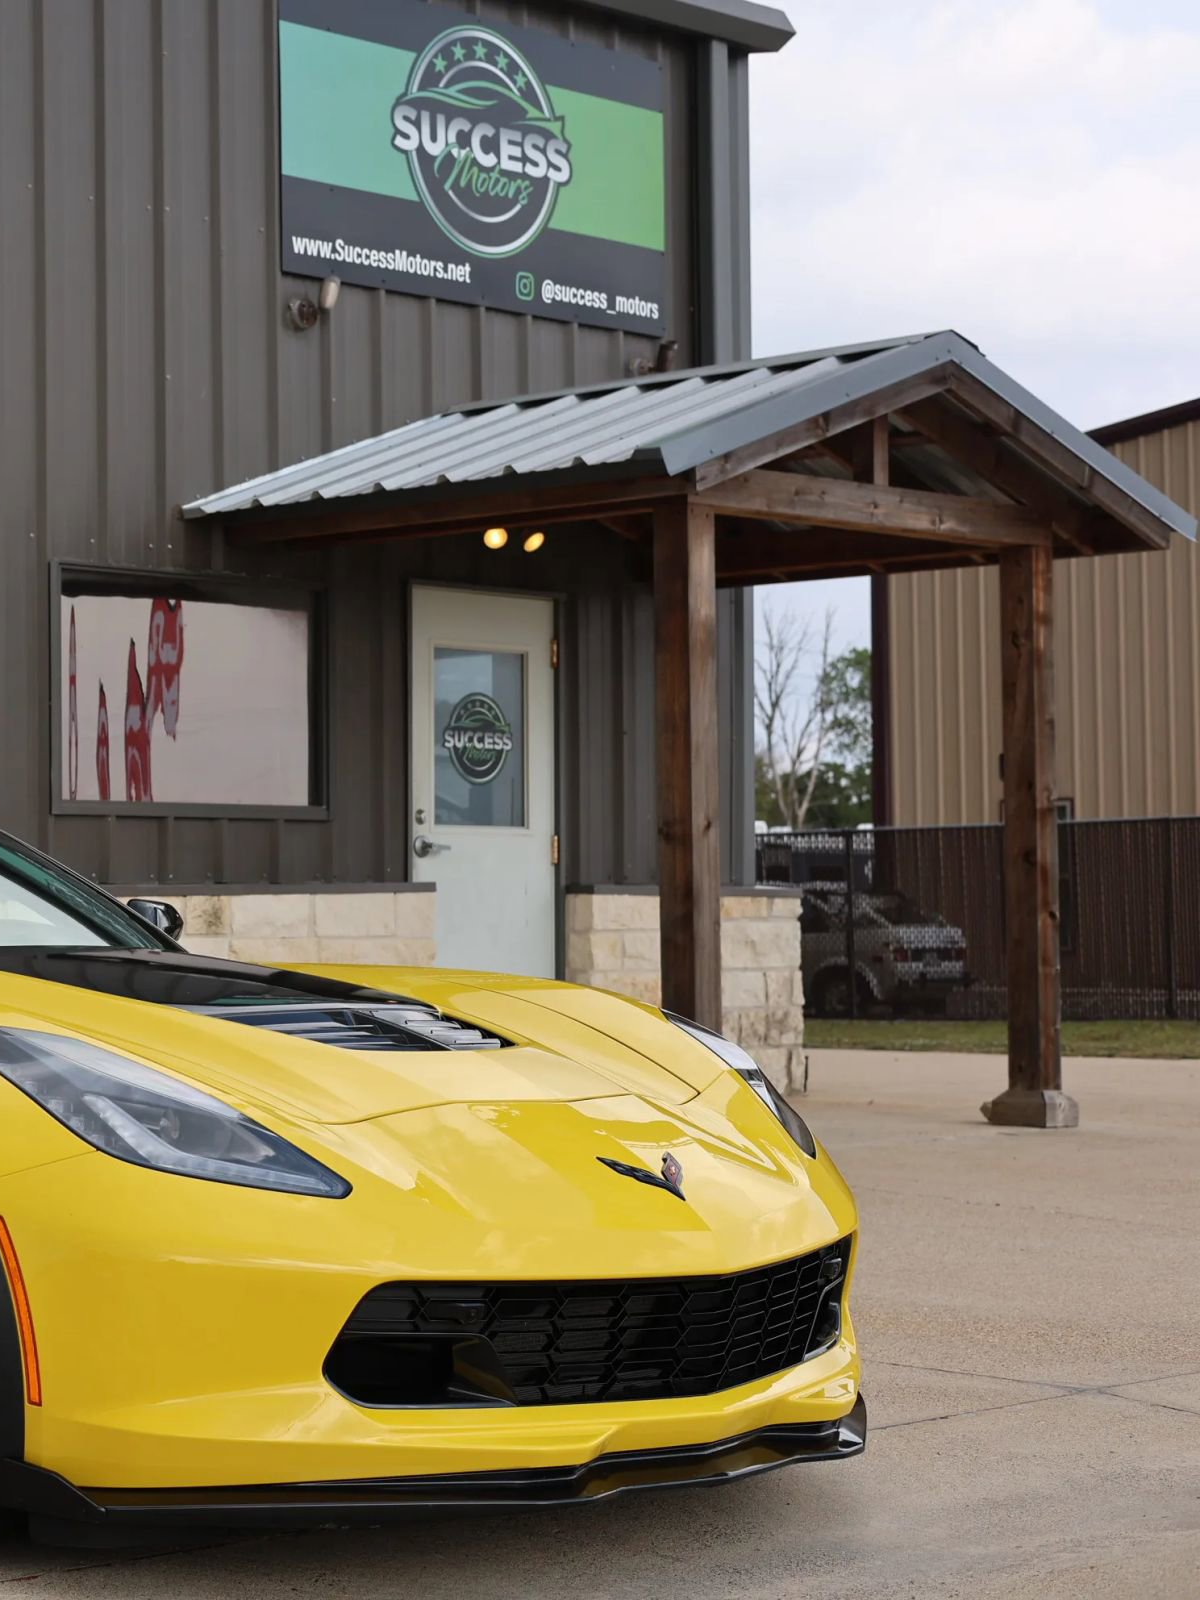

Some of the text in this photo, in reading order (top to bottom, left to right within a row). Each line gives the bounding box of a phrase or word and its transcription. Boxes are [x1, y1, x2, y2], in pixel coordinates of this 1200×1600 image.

[393, 104, 571, 184] SUCCESS
[434, 142, 533, 205] Motors
[291, 235, 471, 284] www.SuccessMotors.net
[541, 278, 660, 320] @success_motors
[443, 729, 513, 751] SUCCESS
